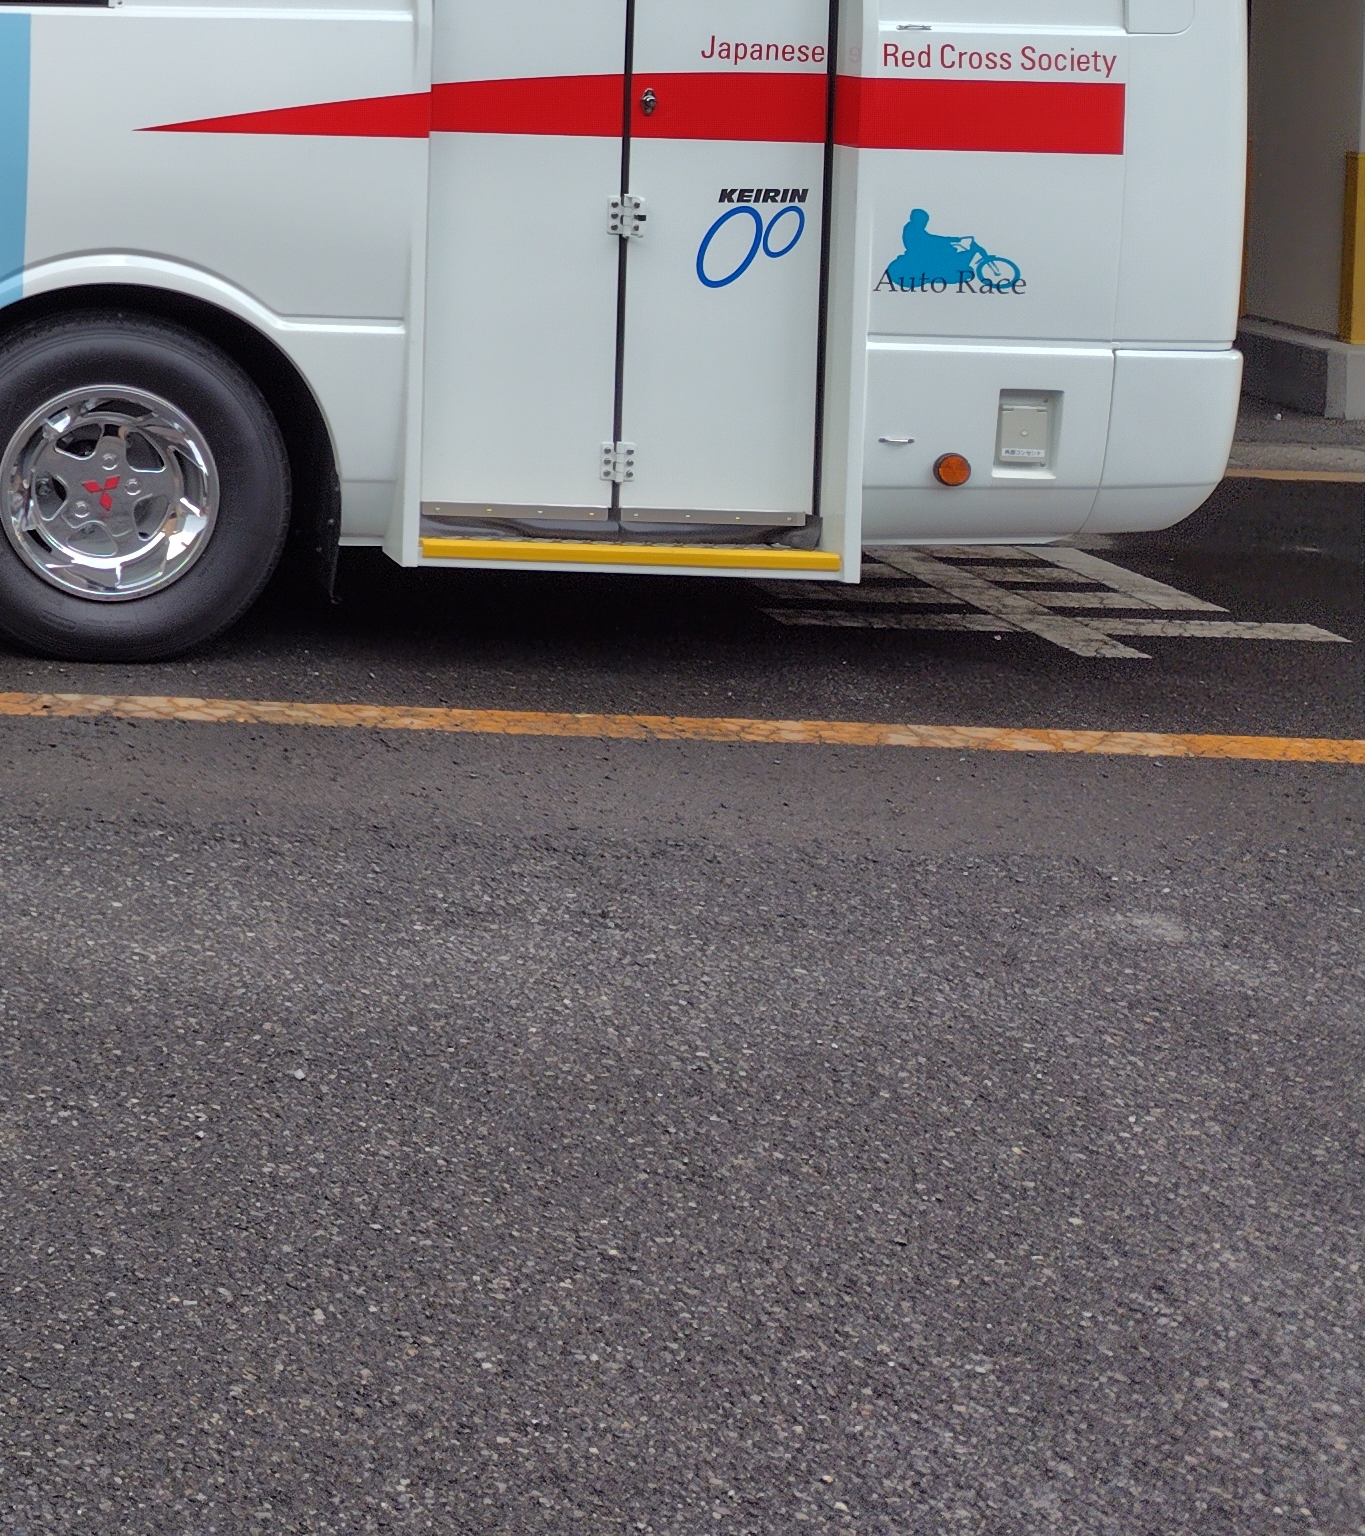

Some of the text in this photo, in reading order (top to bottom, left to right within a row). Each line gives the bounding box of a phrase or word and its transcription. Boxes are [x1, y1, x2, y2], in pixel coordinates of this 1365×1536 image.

[701, 36, 1117, 78] Japanese Red Cross Society
[718, 188, 809, 204] KEIRIN
[873, 269, 1027, 294] Auto Race
